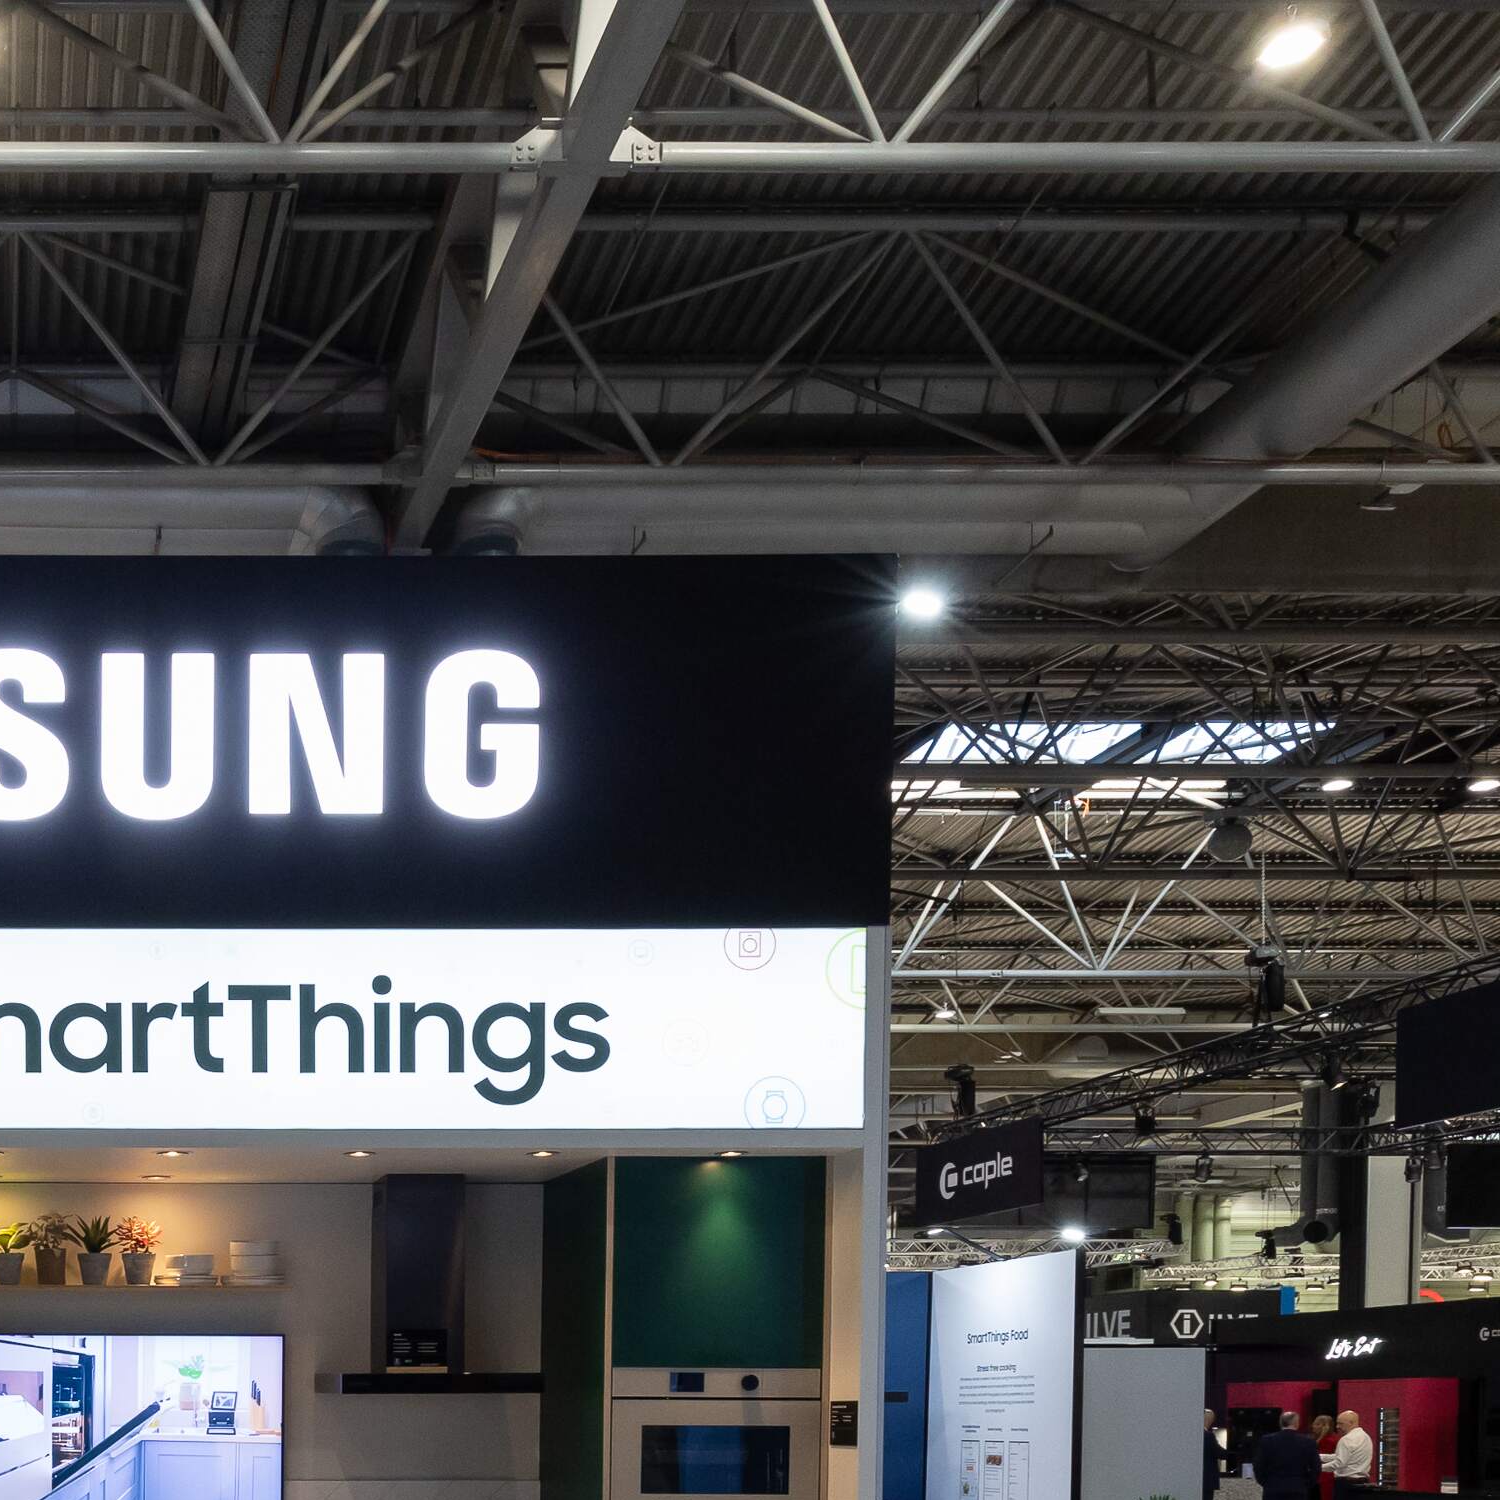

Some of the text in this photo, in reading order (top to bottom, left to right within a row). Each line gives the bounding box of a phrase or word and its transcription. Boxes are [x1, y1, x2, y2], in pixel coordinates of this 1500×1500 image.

[962, 1151, 1013, 1190] caple
[967, 1329, 1029, 1345] SmartThings Food
[1353, 1336, 1383, 1356] Eat
